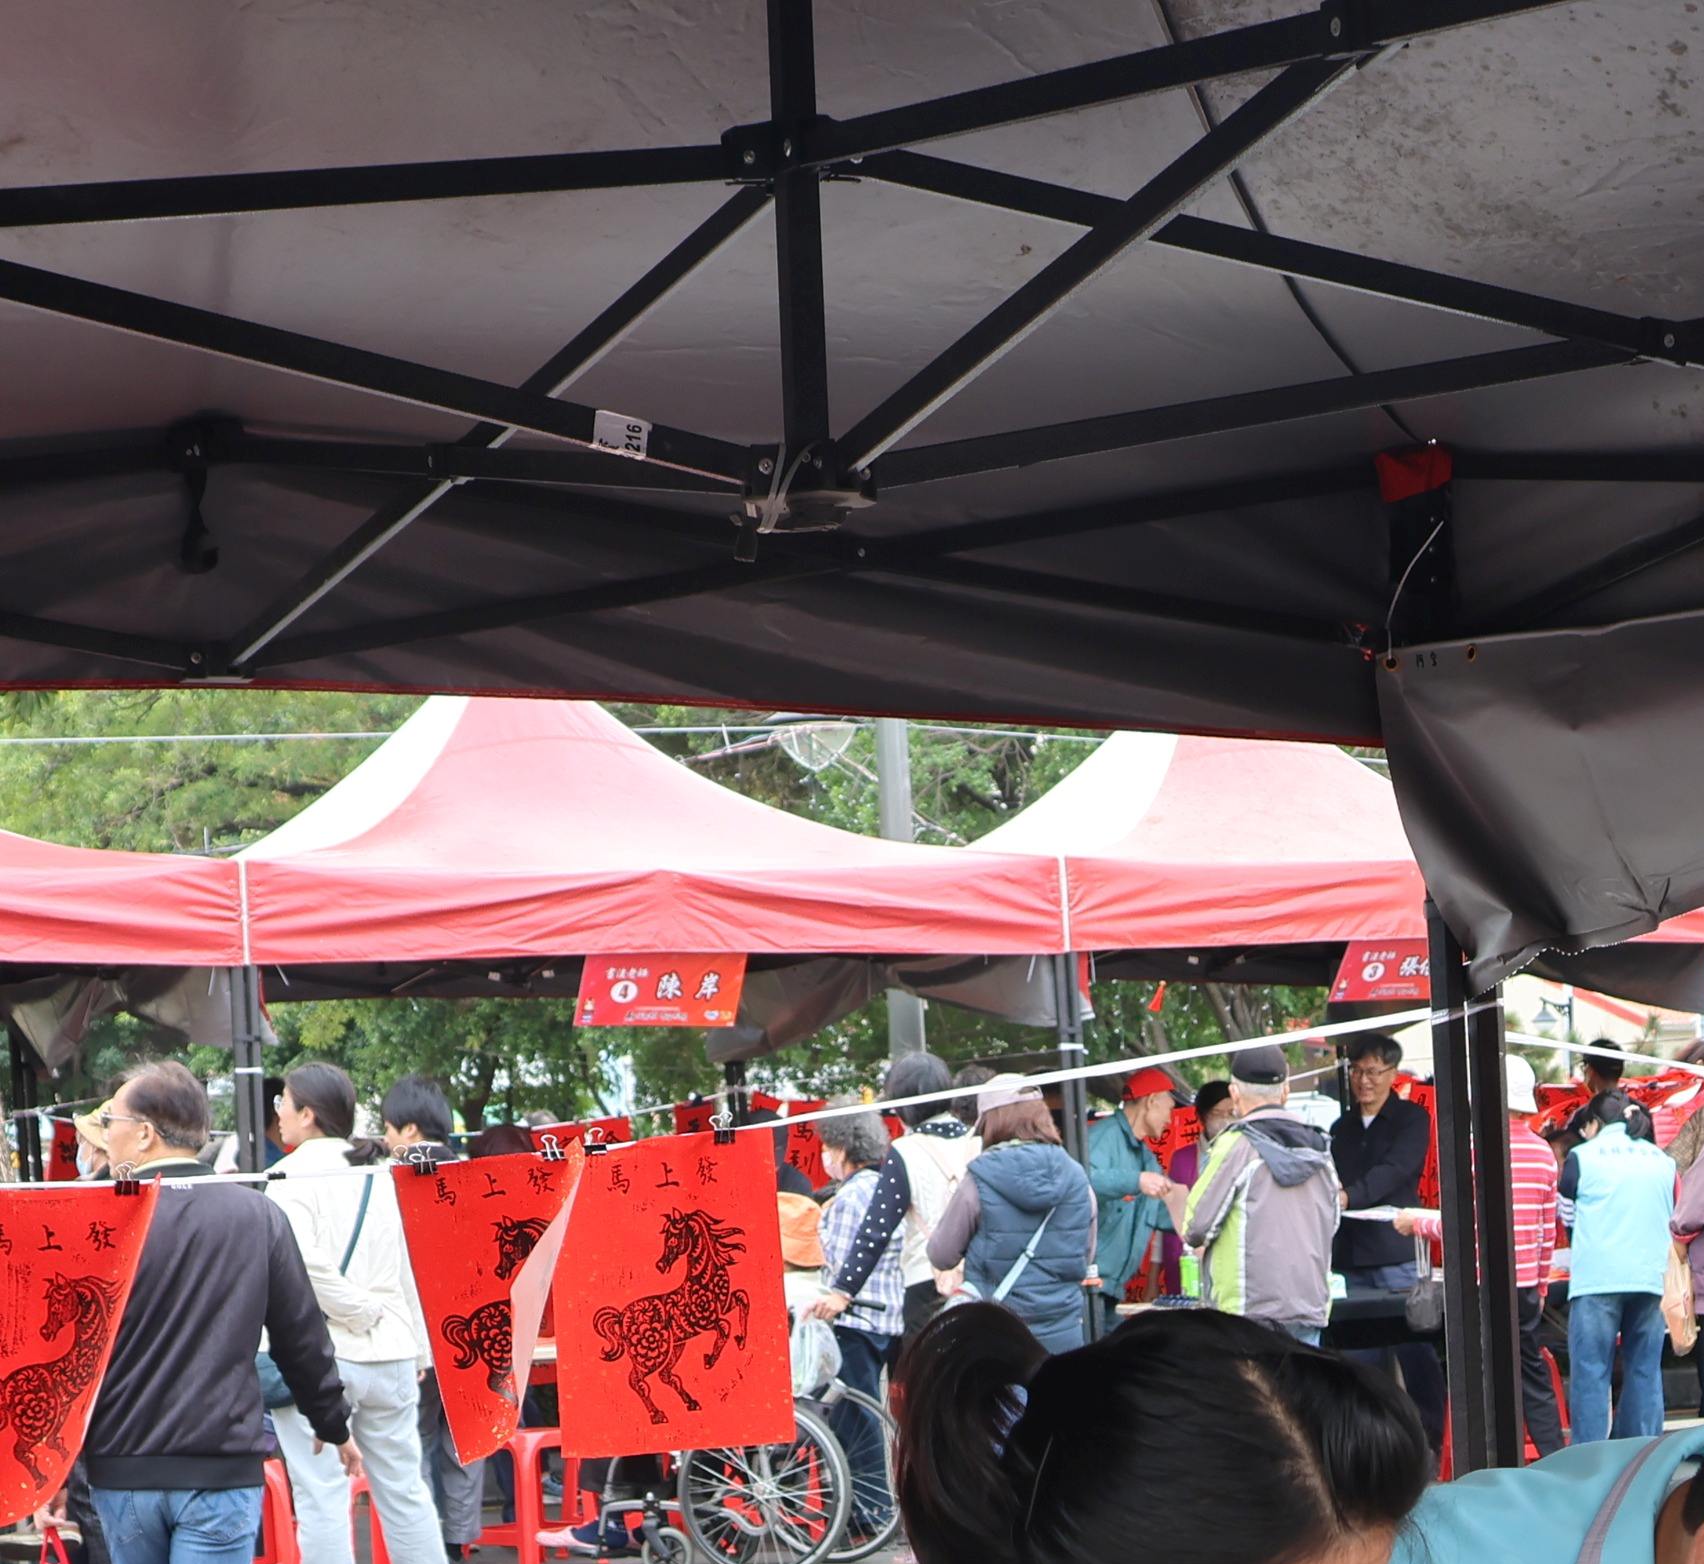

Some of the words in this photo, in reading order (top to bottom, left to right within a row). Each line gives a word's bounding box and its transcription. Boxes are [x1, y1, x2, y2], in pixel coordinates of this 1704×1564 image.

[624, 423, 643, 452] 216
[434, 1166, 555, 1206] 馬上發
[607, 1156, 719, 1195] 馬上發
